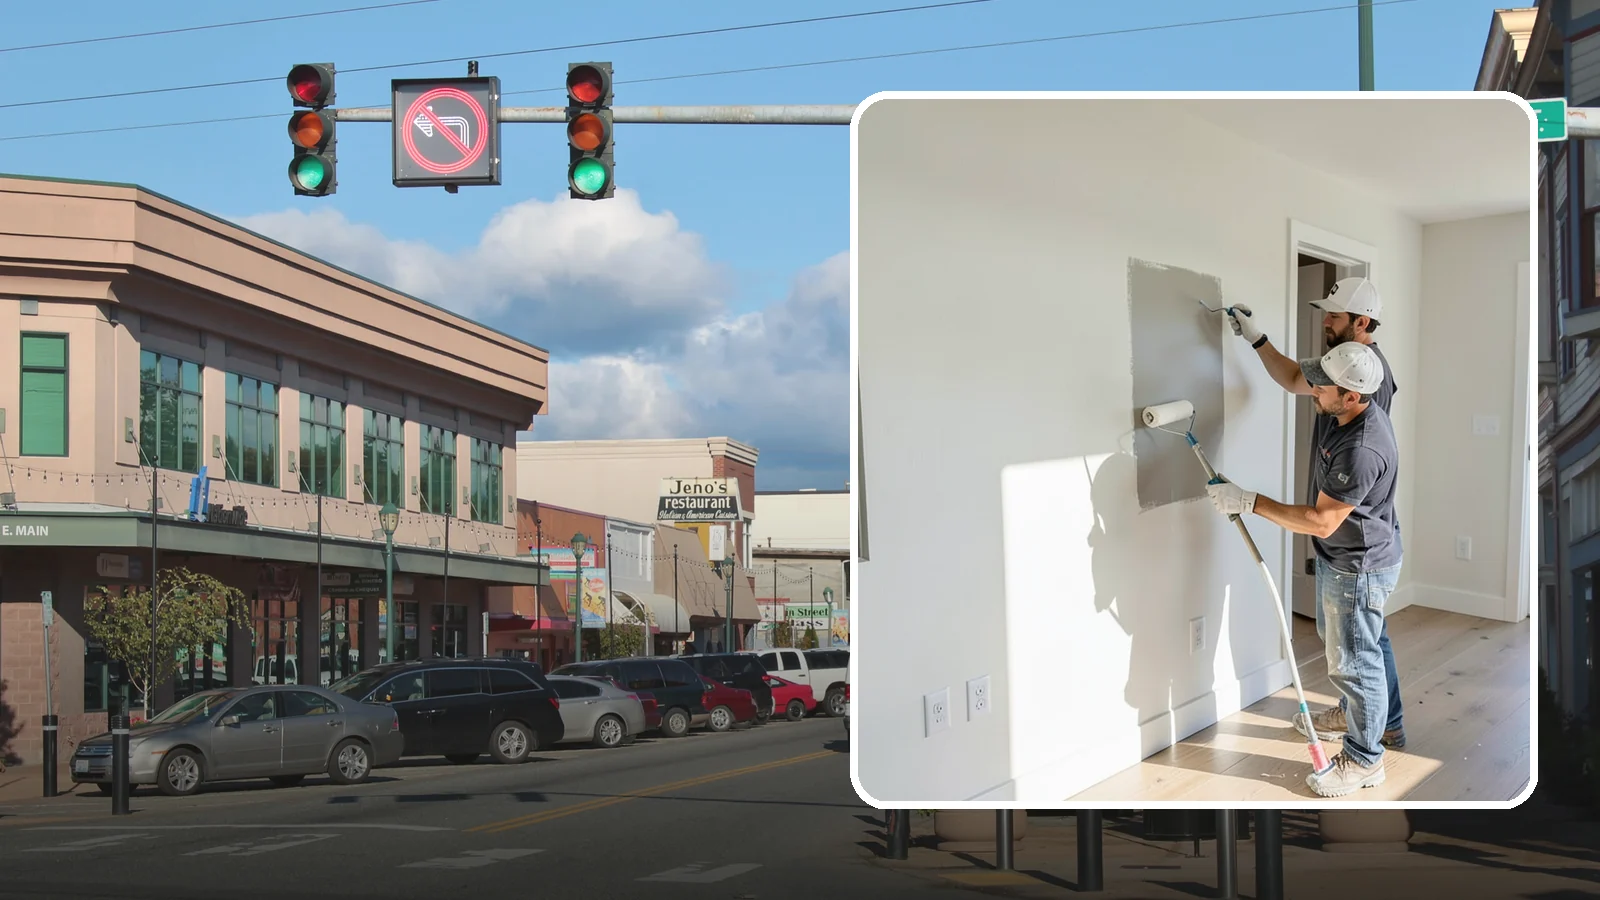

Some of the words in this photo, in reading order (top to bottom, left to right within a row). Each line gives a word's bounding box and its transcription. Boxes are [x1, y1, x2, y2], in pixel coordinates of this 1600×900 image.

[669, 480, 728, 494] Jeno's
[664, 496, 731, 509] restaurant
[658, 510, 681, 519] Italian
[686, 510, 714, 519] American
[715, 510, 737, 519] Cuisine
[2, 525, 13, 536] E.
[15, 525, 49, 536] MAIN
[797, 607, 829, 616] Street
